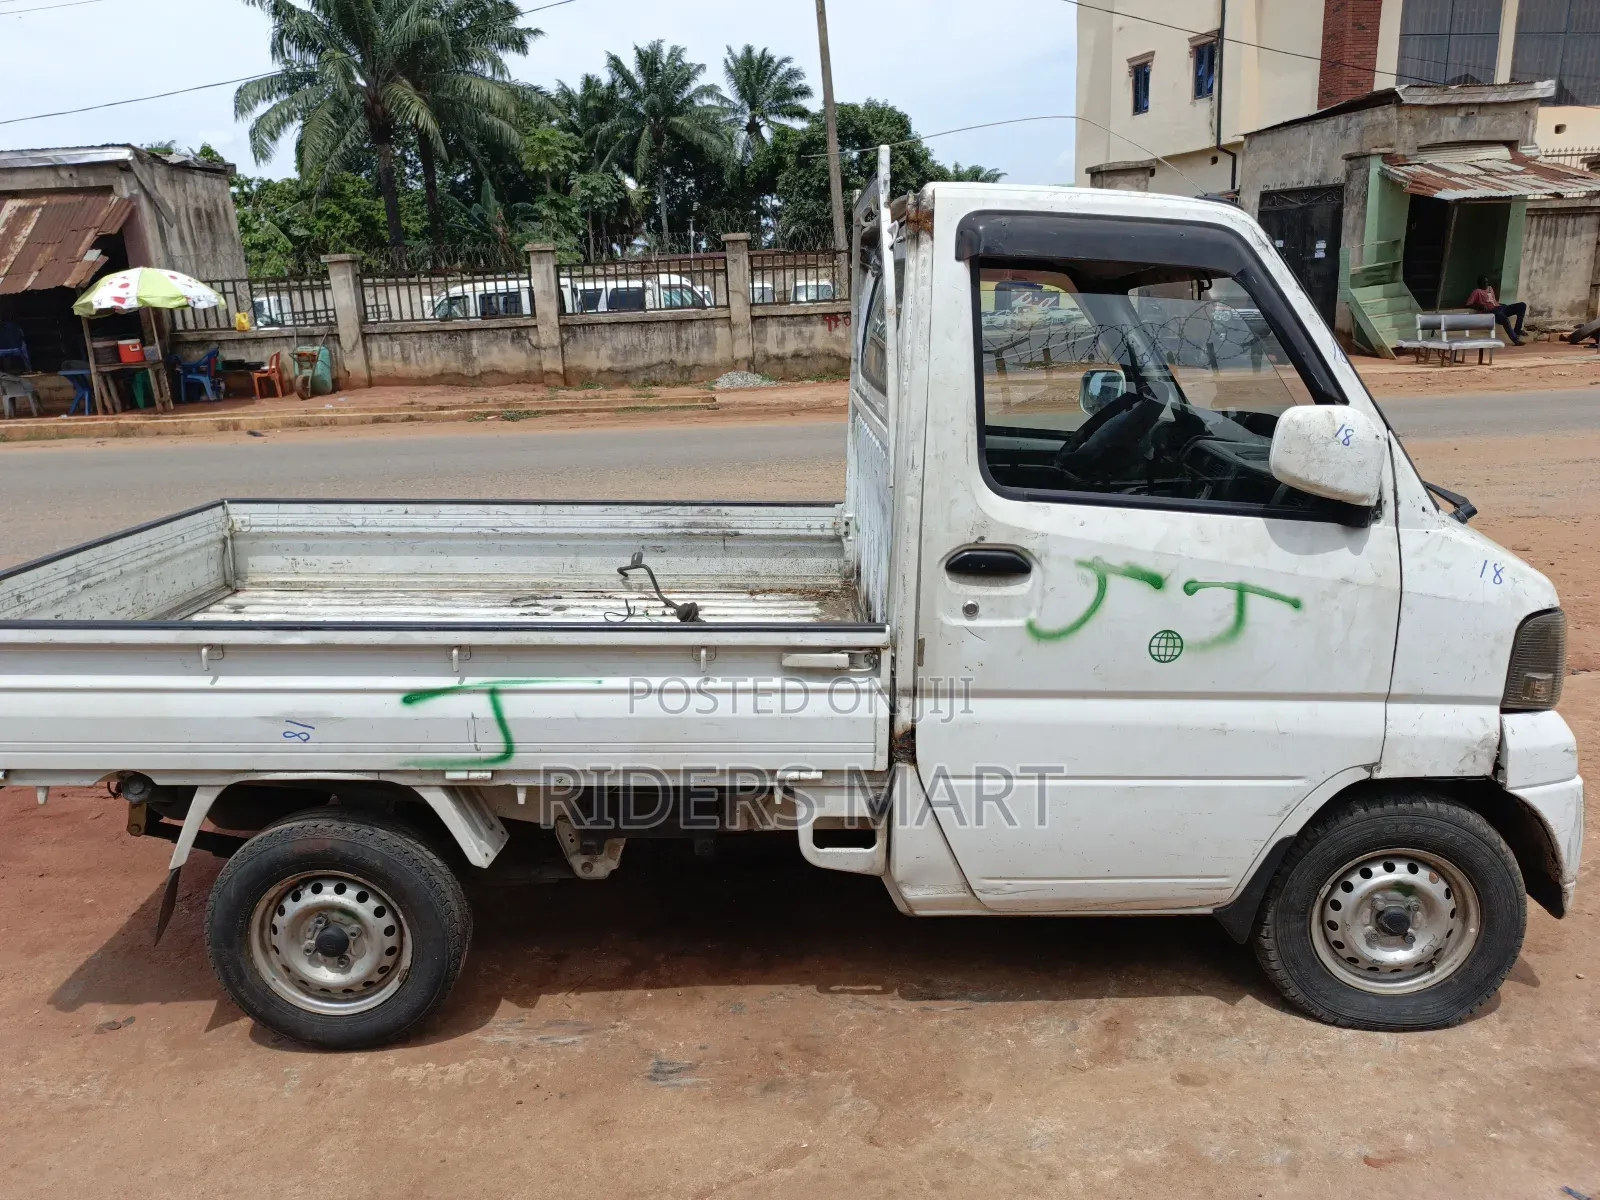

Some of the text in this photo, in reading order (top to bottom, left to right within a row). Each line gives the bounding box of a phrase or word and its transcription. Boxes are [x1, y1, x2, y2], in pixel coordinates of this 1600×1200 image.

[1334, 423, 1355, 447] 18
[1479, 559, 1505, 585] 18
[281, 719, 316, 744] 18
